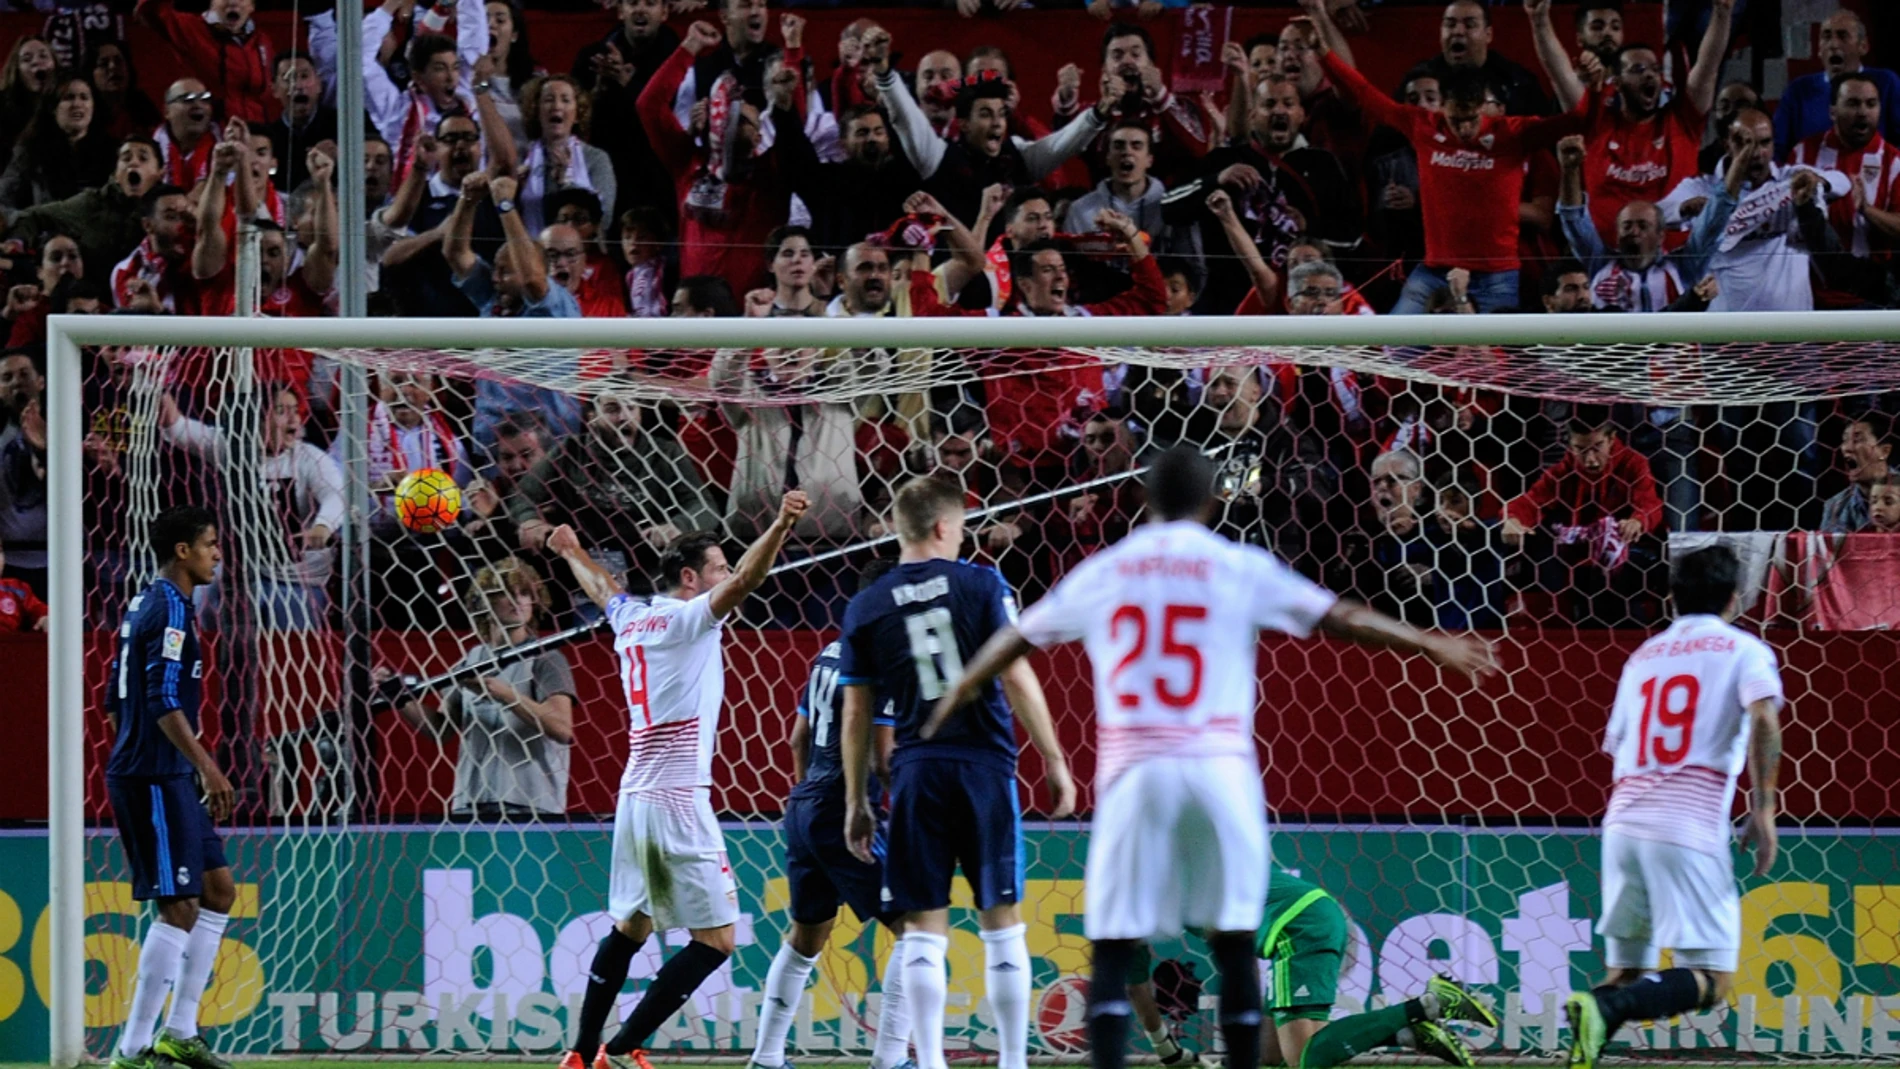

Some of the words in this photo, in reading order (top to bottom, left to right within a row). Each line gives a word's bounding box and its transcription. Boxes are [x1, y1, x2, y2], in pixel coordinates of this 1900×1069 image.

[1430, 151, 1494, 172] Malaysia
[1606, 162, 1666, 185] Malaysia
[625, 644, 653, 728] 4
[904, 606, 964, 701] 8
[1109, 604, 1207, 708] 25
[809, 665, 840, 747] 14
[1636, 674, 1700, 768] 19
